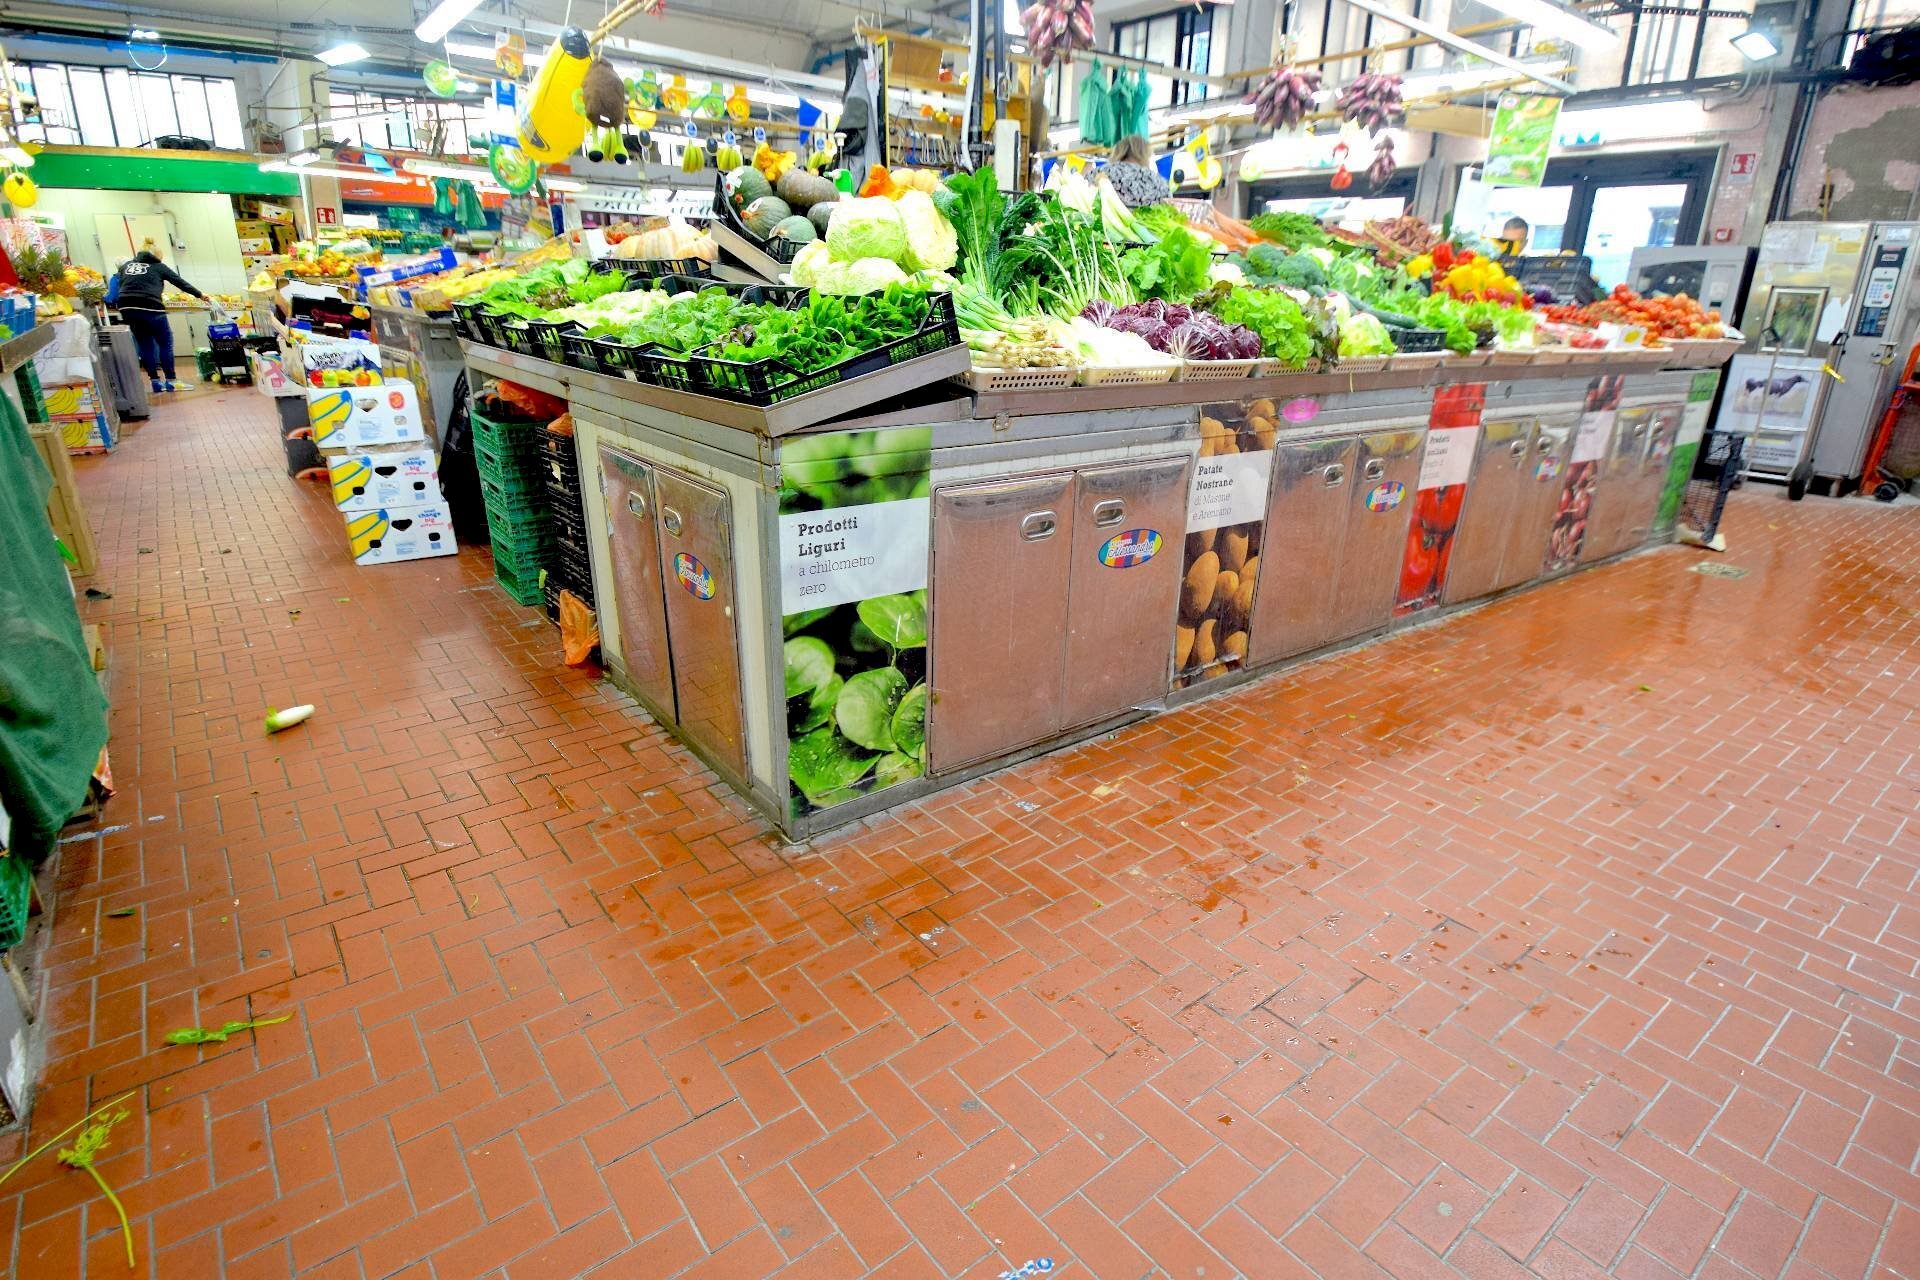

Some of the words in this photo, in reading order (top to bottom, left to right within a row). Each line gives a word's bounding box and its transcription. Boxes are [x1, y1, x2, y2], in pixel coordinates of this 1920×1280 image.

[1198, 464, 1223, 476] Patate
[1196, 478, 1234, 491] Nostrane
[798, 516, 859, 537] Prodotti
[798, 537, 846, 558] Liguri
[798, 567, 806, 576] a
[809, 555, 875, 574] chilometro
[799, 582, 827, 597] zero
